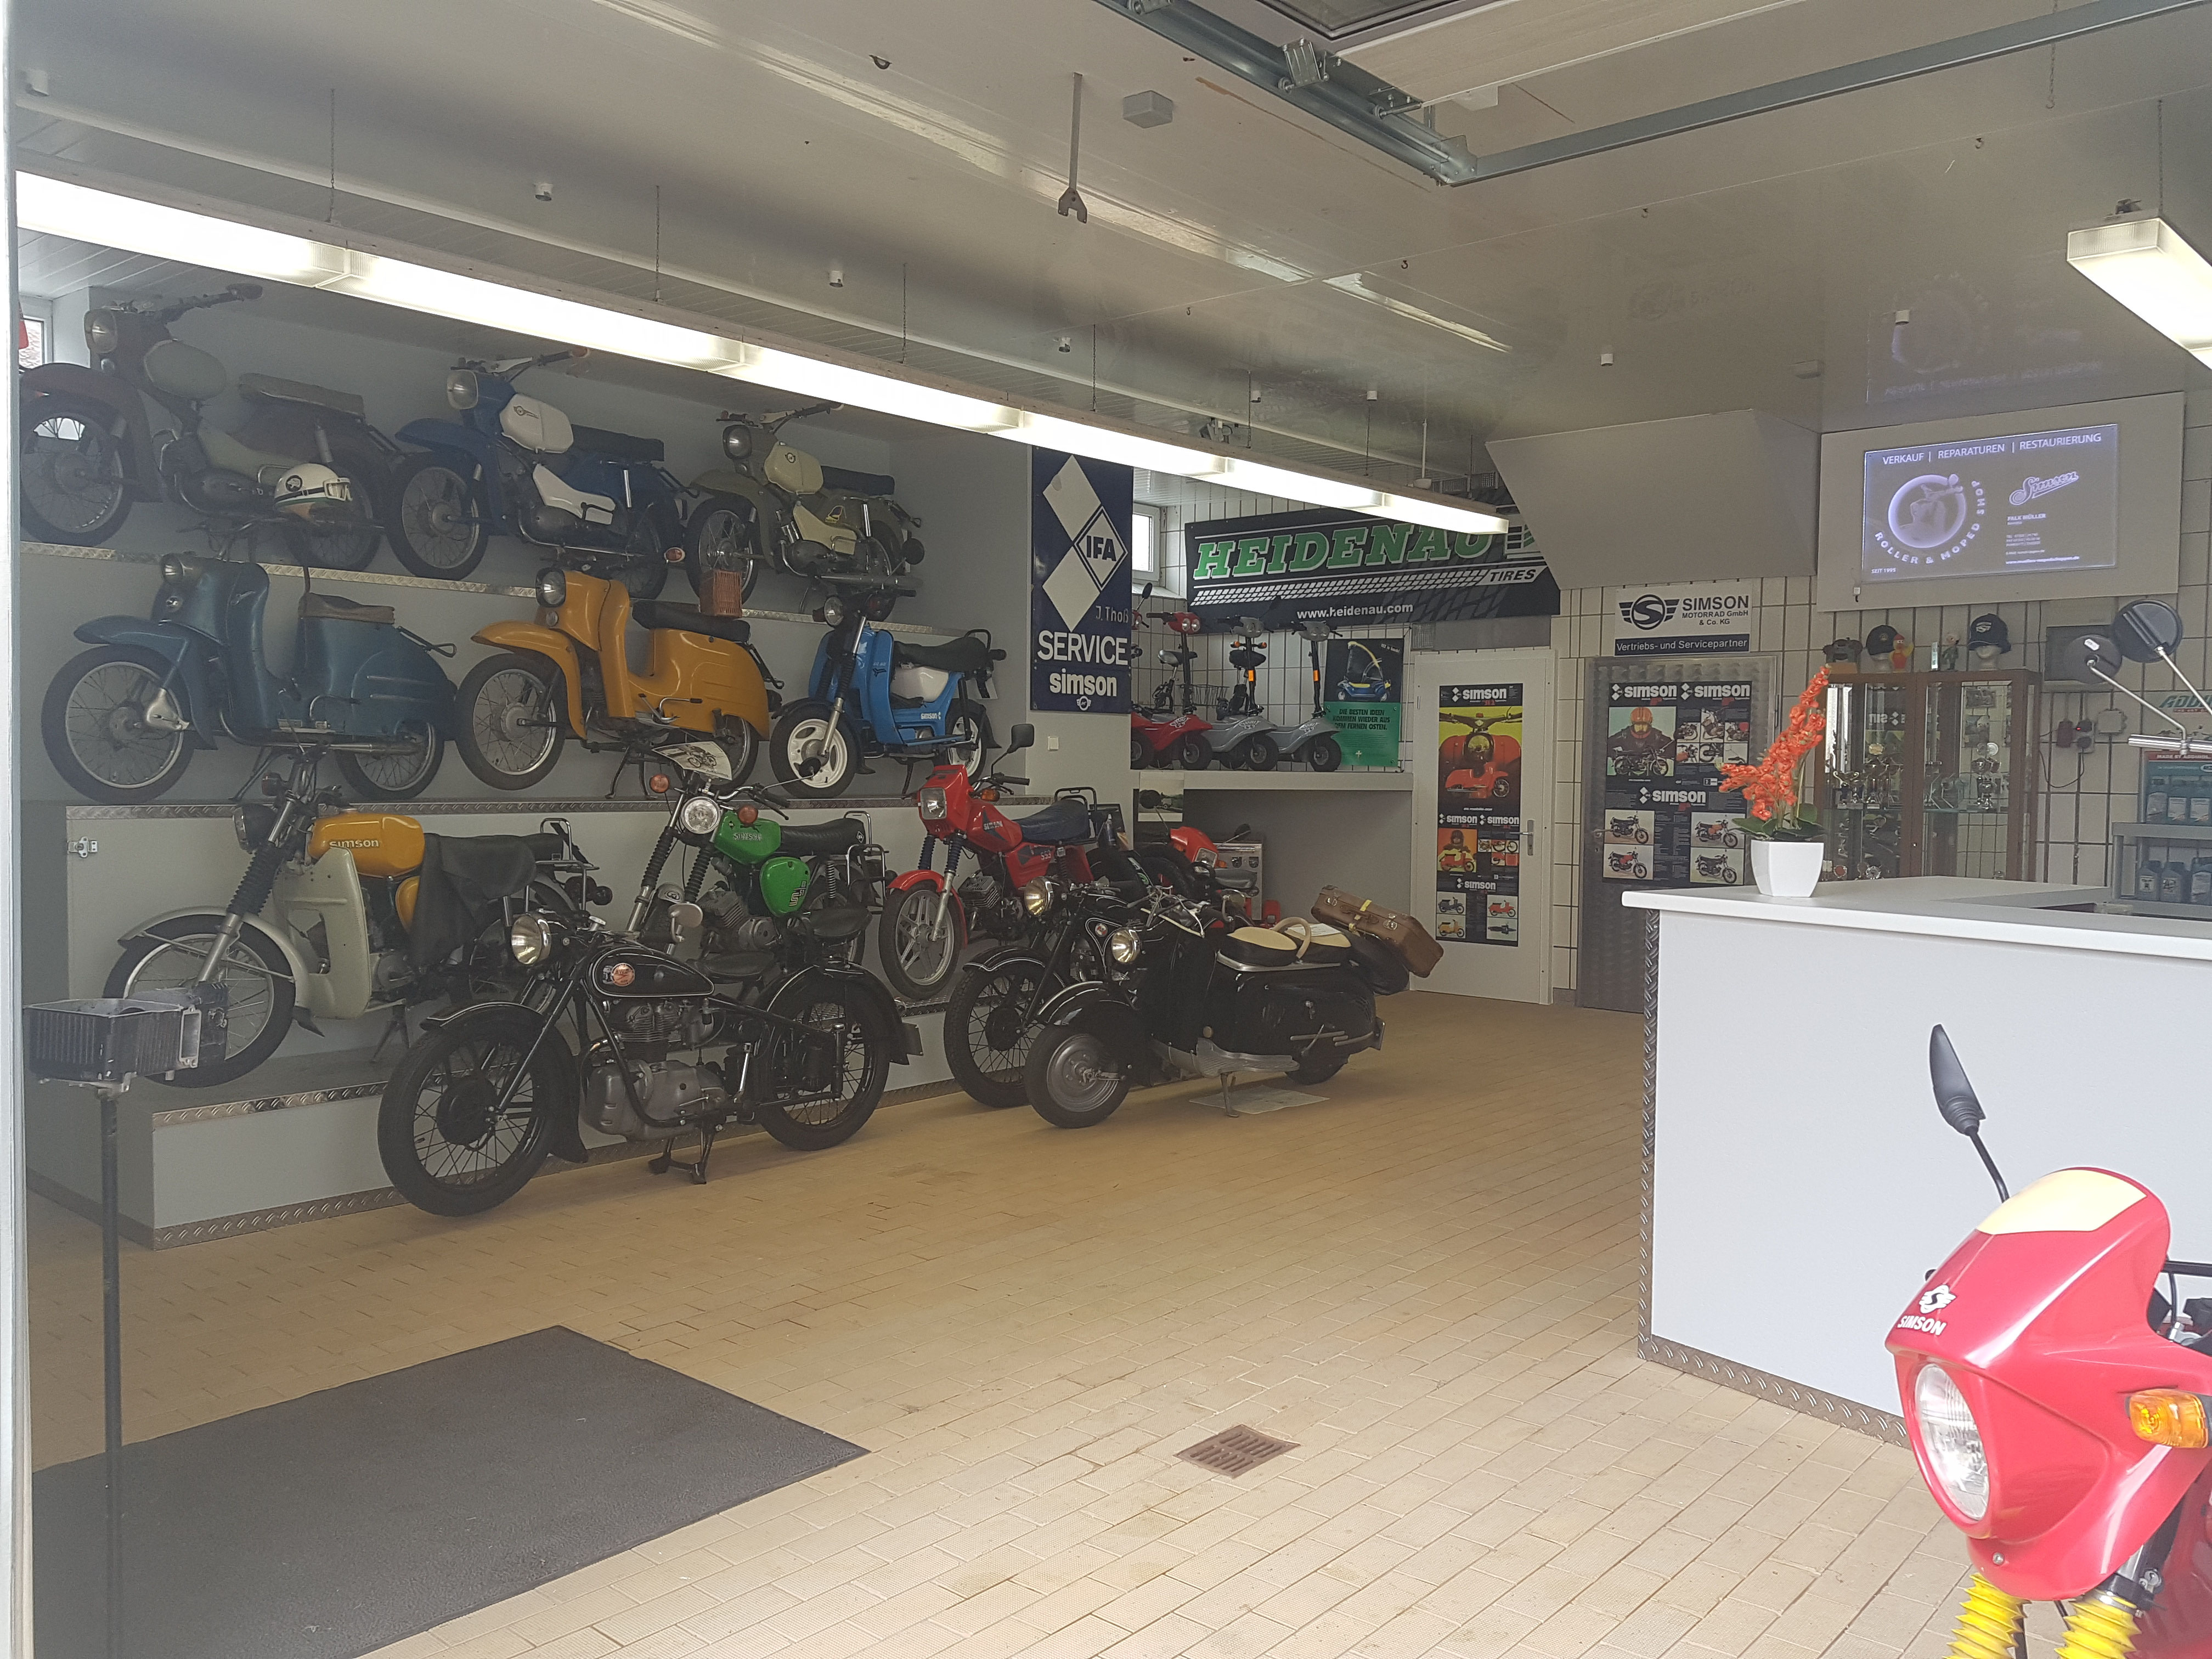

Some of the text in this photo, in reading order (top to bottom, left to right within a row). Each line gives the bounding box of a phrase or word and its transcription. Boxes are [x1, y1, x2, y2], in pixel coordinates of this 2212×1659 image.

[1882, 433, 2101, 465] VERKAUF REPARATUREN RESTAURIERUNG
[1875, 532, 1918, 564] ROLLER
[1940, 523, 1980, 560] MOPED
[1971, 480, 1985, 515] SHOP
[1087, 535, 1117, 561] IFA
[1193, 523, 1493, 579] HEIDENAU
[1489, 568, 1536, 583] TIRES
[1682, 595, 1749, 611] SIMSON
[1296, 603, 1414, 619] www.heidenau.com
[1682, 611, 1725, 619] MOTORRAD
[1038, 630, 1128, 665] SERVICE
[1616, 639, 1748, 651] Vertriebs- und Servicepartner
[1049, 668, 1117, 697] simson
[1463, 689, 1507, 699] simson
[1624, 685, 1677, 698] simson
[1694, 684, 1750, 697] simson
[1652, 790, 1706, 803] simson
[1447, 815, 1477, 823] simson
[1487, 816, 1519, 825] simson
[329, 839, 379, 848] simson
[1464, 881, 1496, 890] simson
[1897, 1316, 1947, 1335] SIMSON
